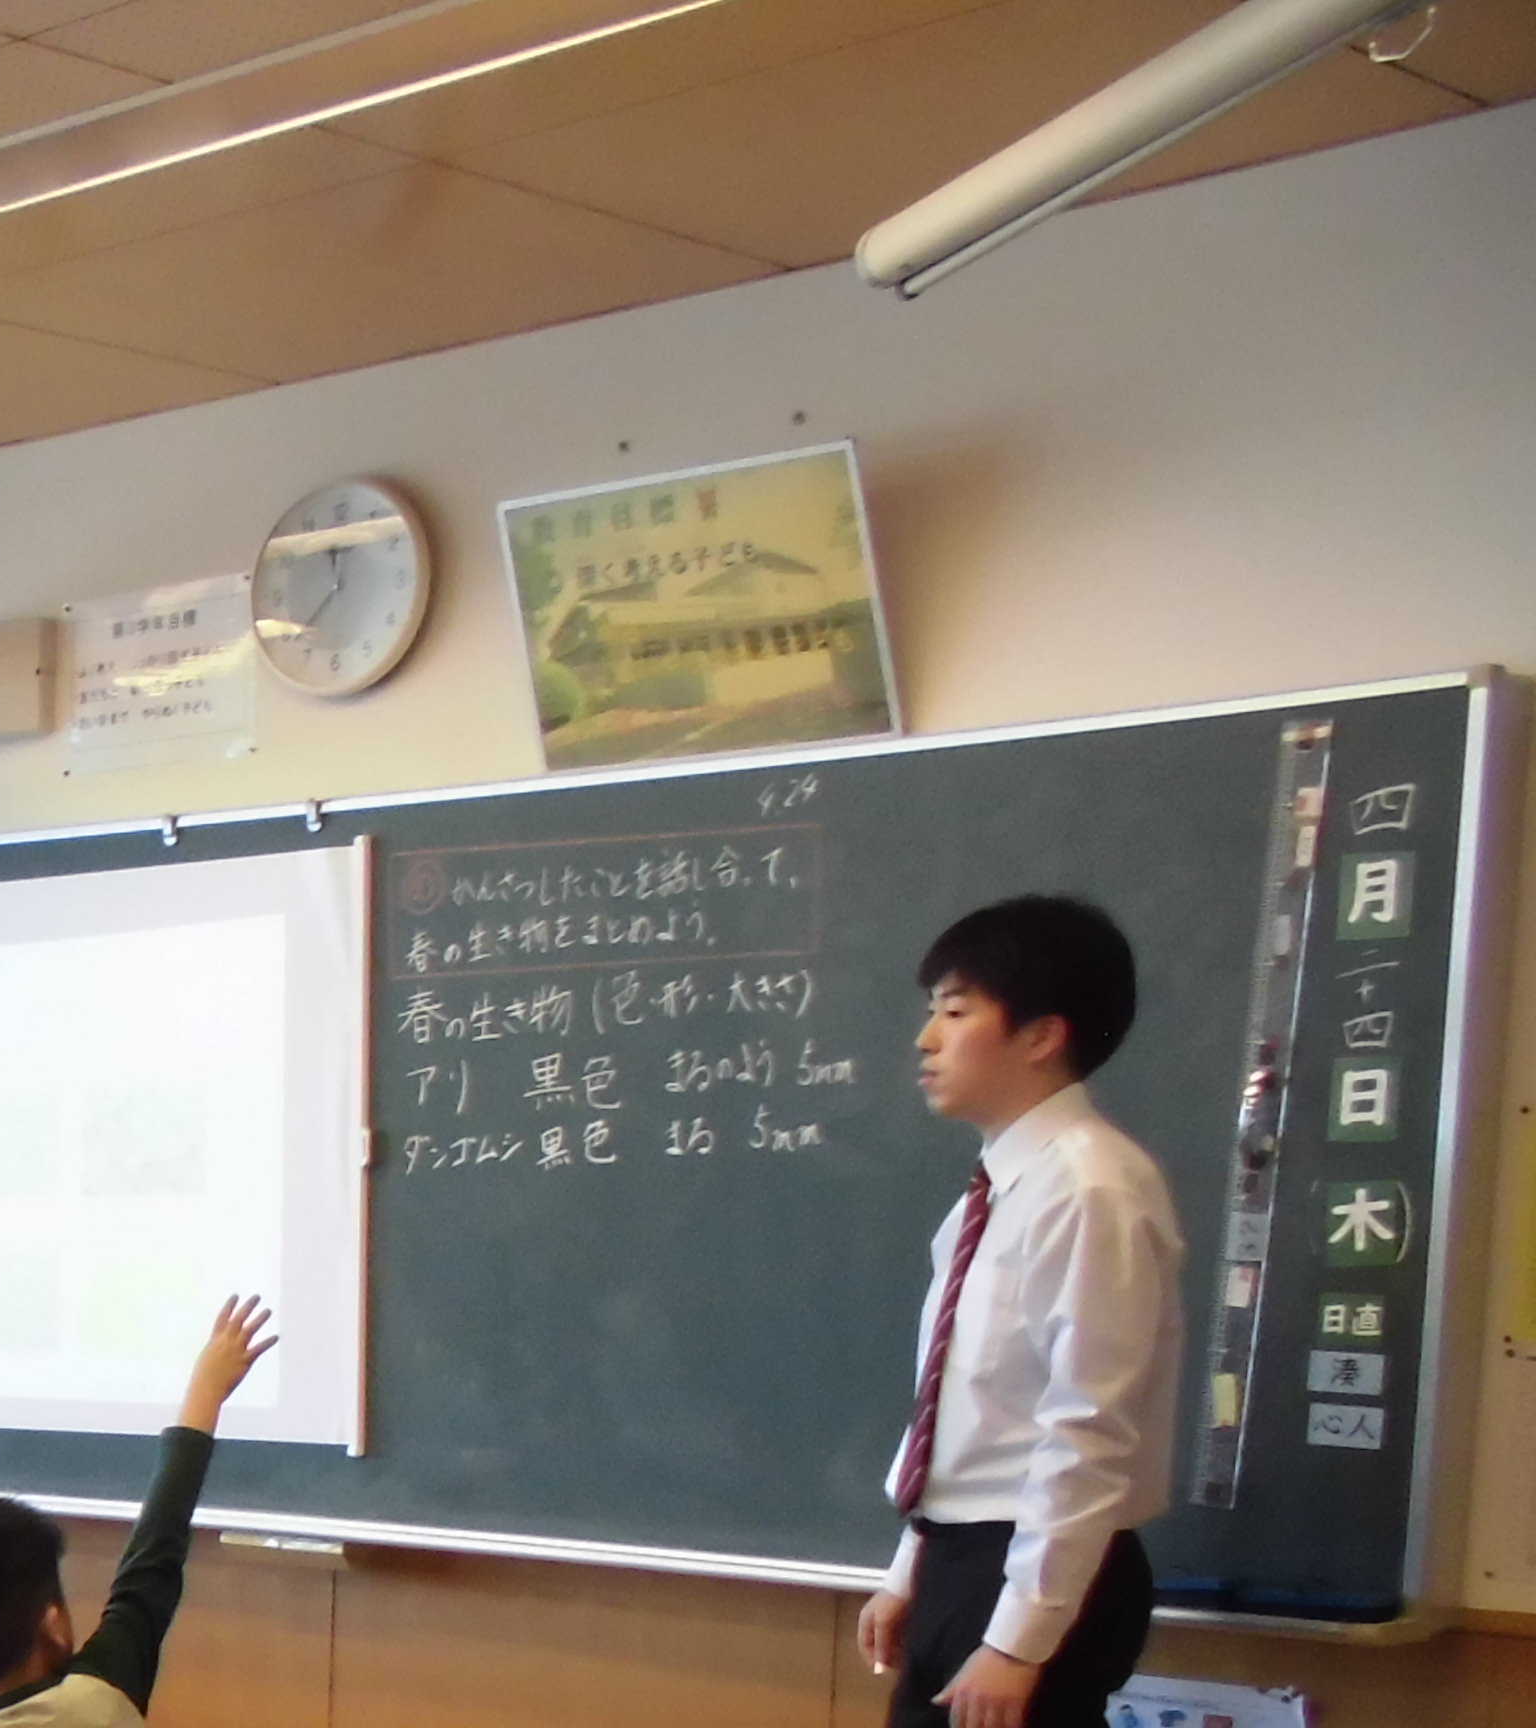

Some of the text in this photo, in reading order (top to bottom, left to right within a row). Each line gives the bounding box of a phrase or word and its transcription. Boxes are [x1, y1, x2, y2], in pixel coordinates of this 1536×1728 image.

[404, 1059, 469, 1115] アリ
[523, 1052, 622, 1111] 黒色
[535, 1119, 618, 1171] 黒色
[664, 1116, 715, 1156] まる
[748, 1102, 823, 1152] 5mm
[1321, 1303, 1383, 1336] 日直
